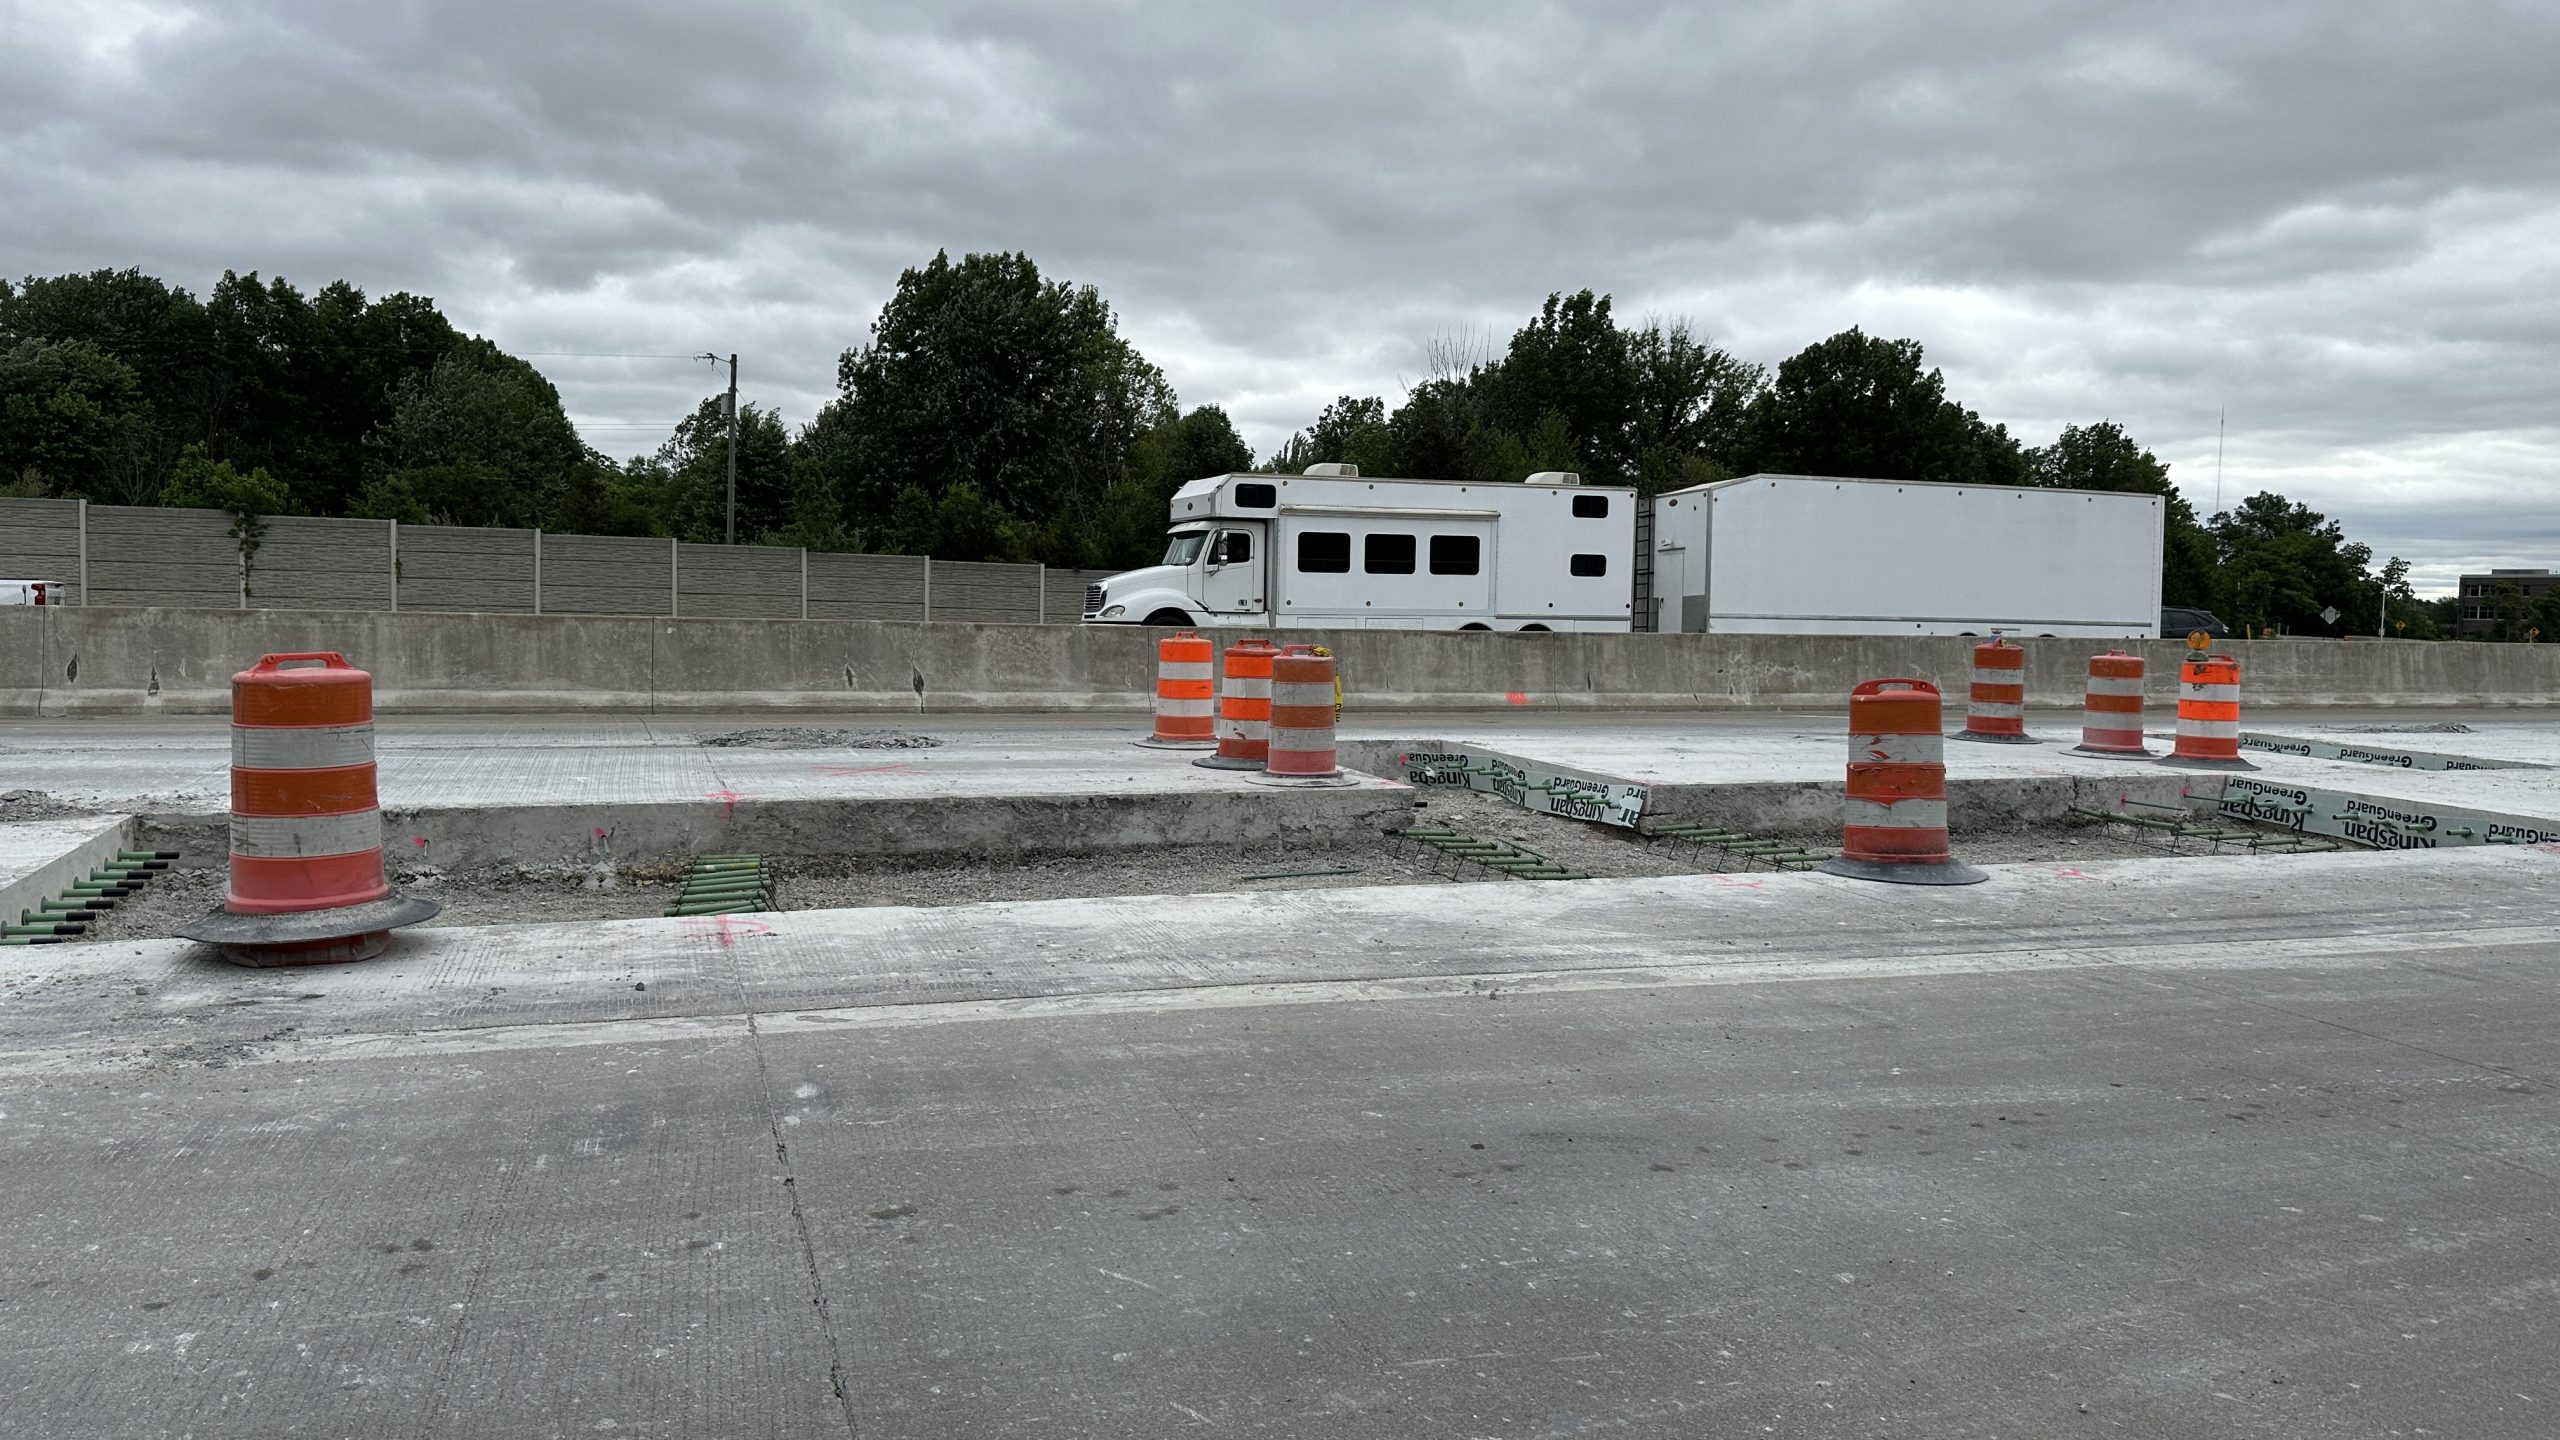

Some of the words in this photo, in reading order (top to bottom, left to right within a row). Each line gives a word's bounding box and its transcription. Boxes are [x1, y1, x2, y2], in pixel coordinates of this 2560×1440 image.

[2340, 748, 2412, 768] GreenGuard
[1553, 777, 1609, 799] GreenGuard
[1550, 797, 1605, 821] Kingspan
[2347, 800, 2437, 832] GreenGuard
